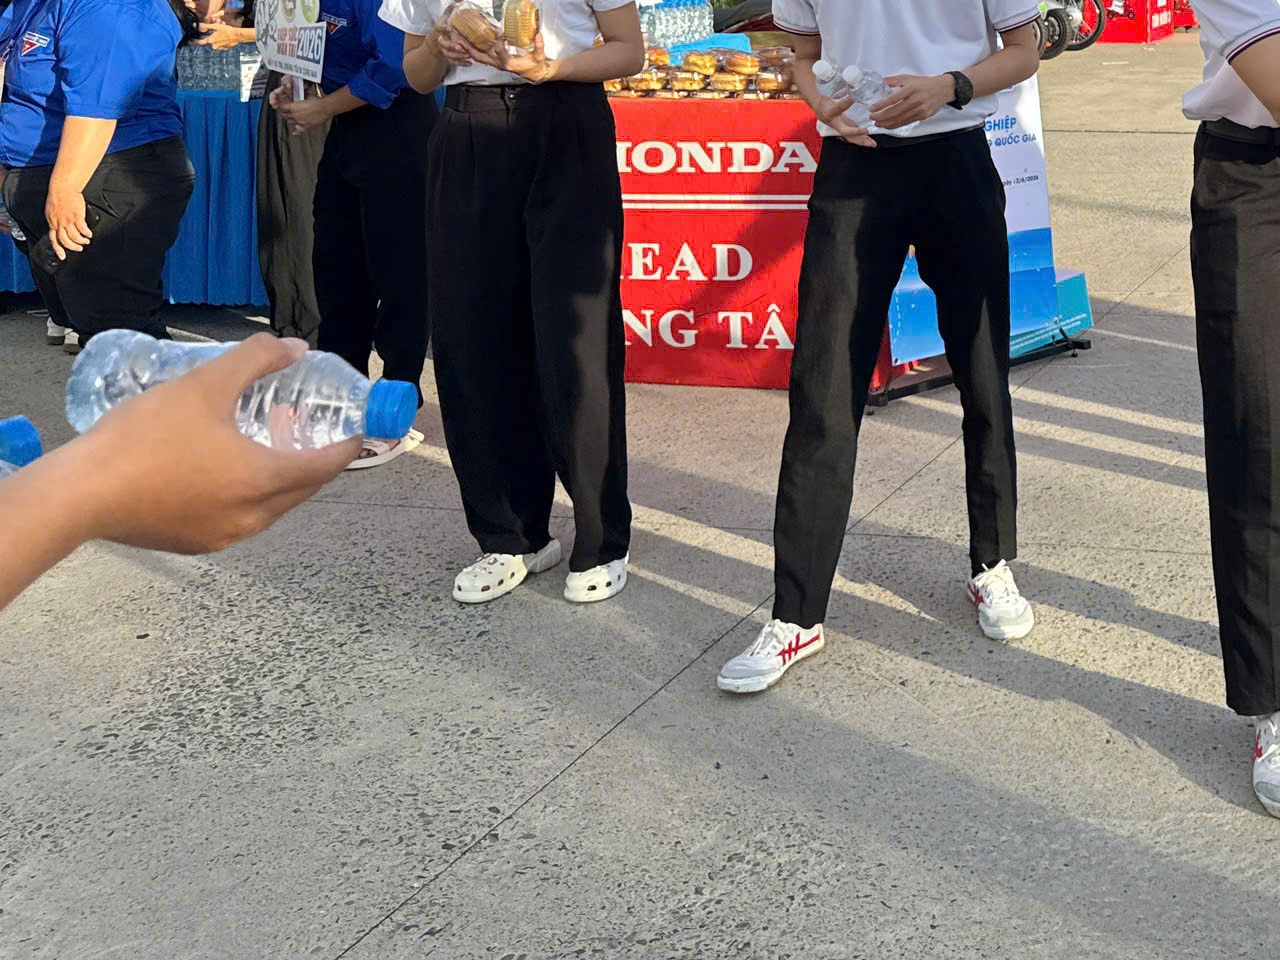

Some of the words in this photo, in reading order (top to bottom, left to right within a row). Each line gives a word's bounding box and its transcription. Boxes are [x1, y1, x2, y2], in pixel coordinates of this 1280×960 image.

[297, 27, 322, 60] 2026
[984, 115, 1017, 133] GHIỆP
[994, 132, 1020, 147] QUỐC
[1021, 133, 1037, 143] GIA
[620, 242, 753, 281] EAD
[622, 309, 699, 348] NG
[717, 303, 795, 350] TÂ
